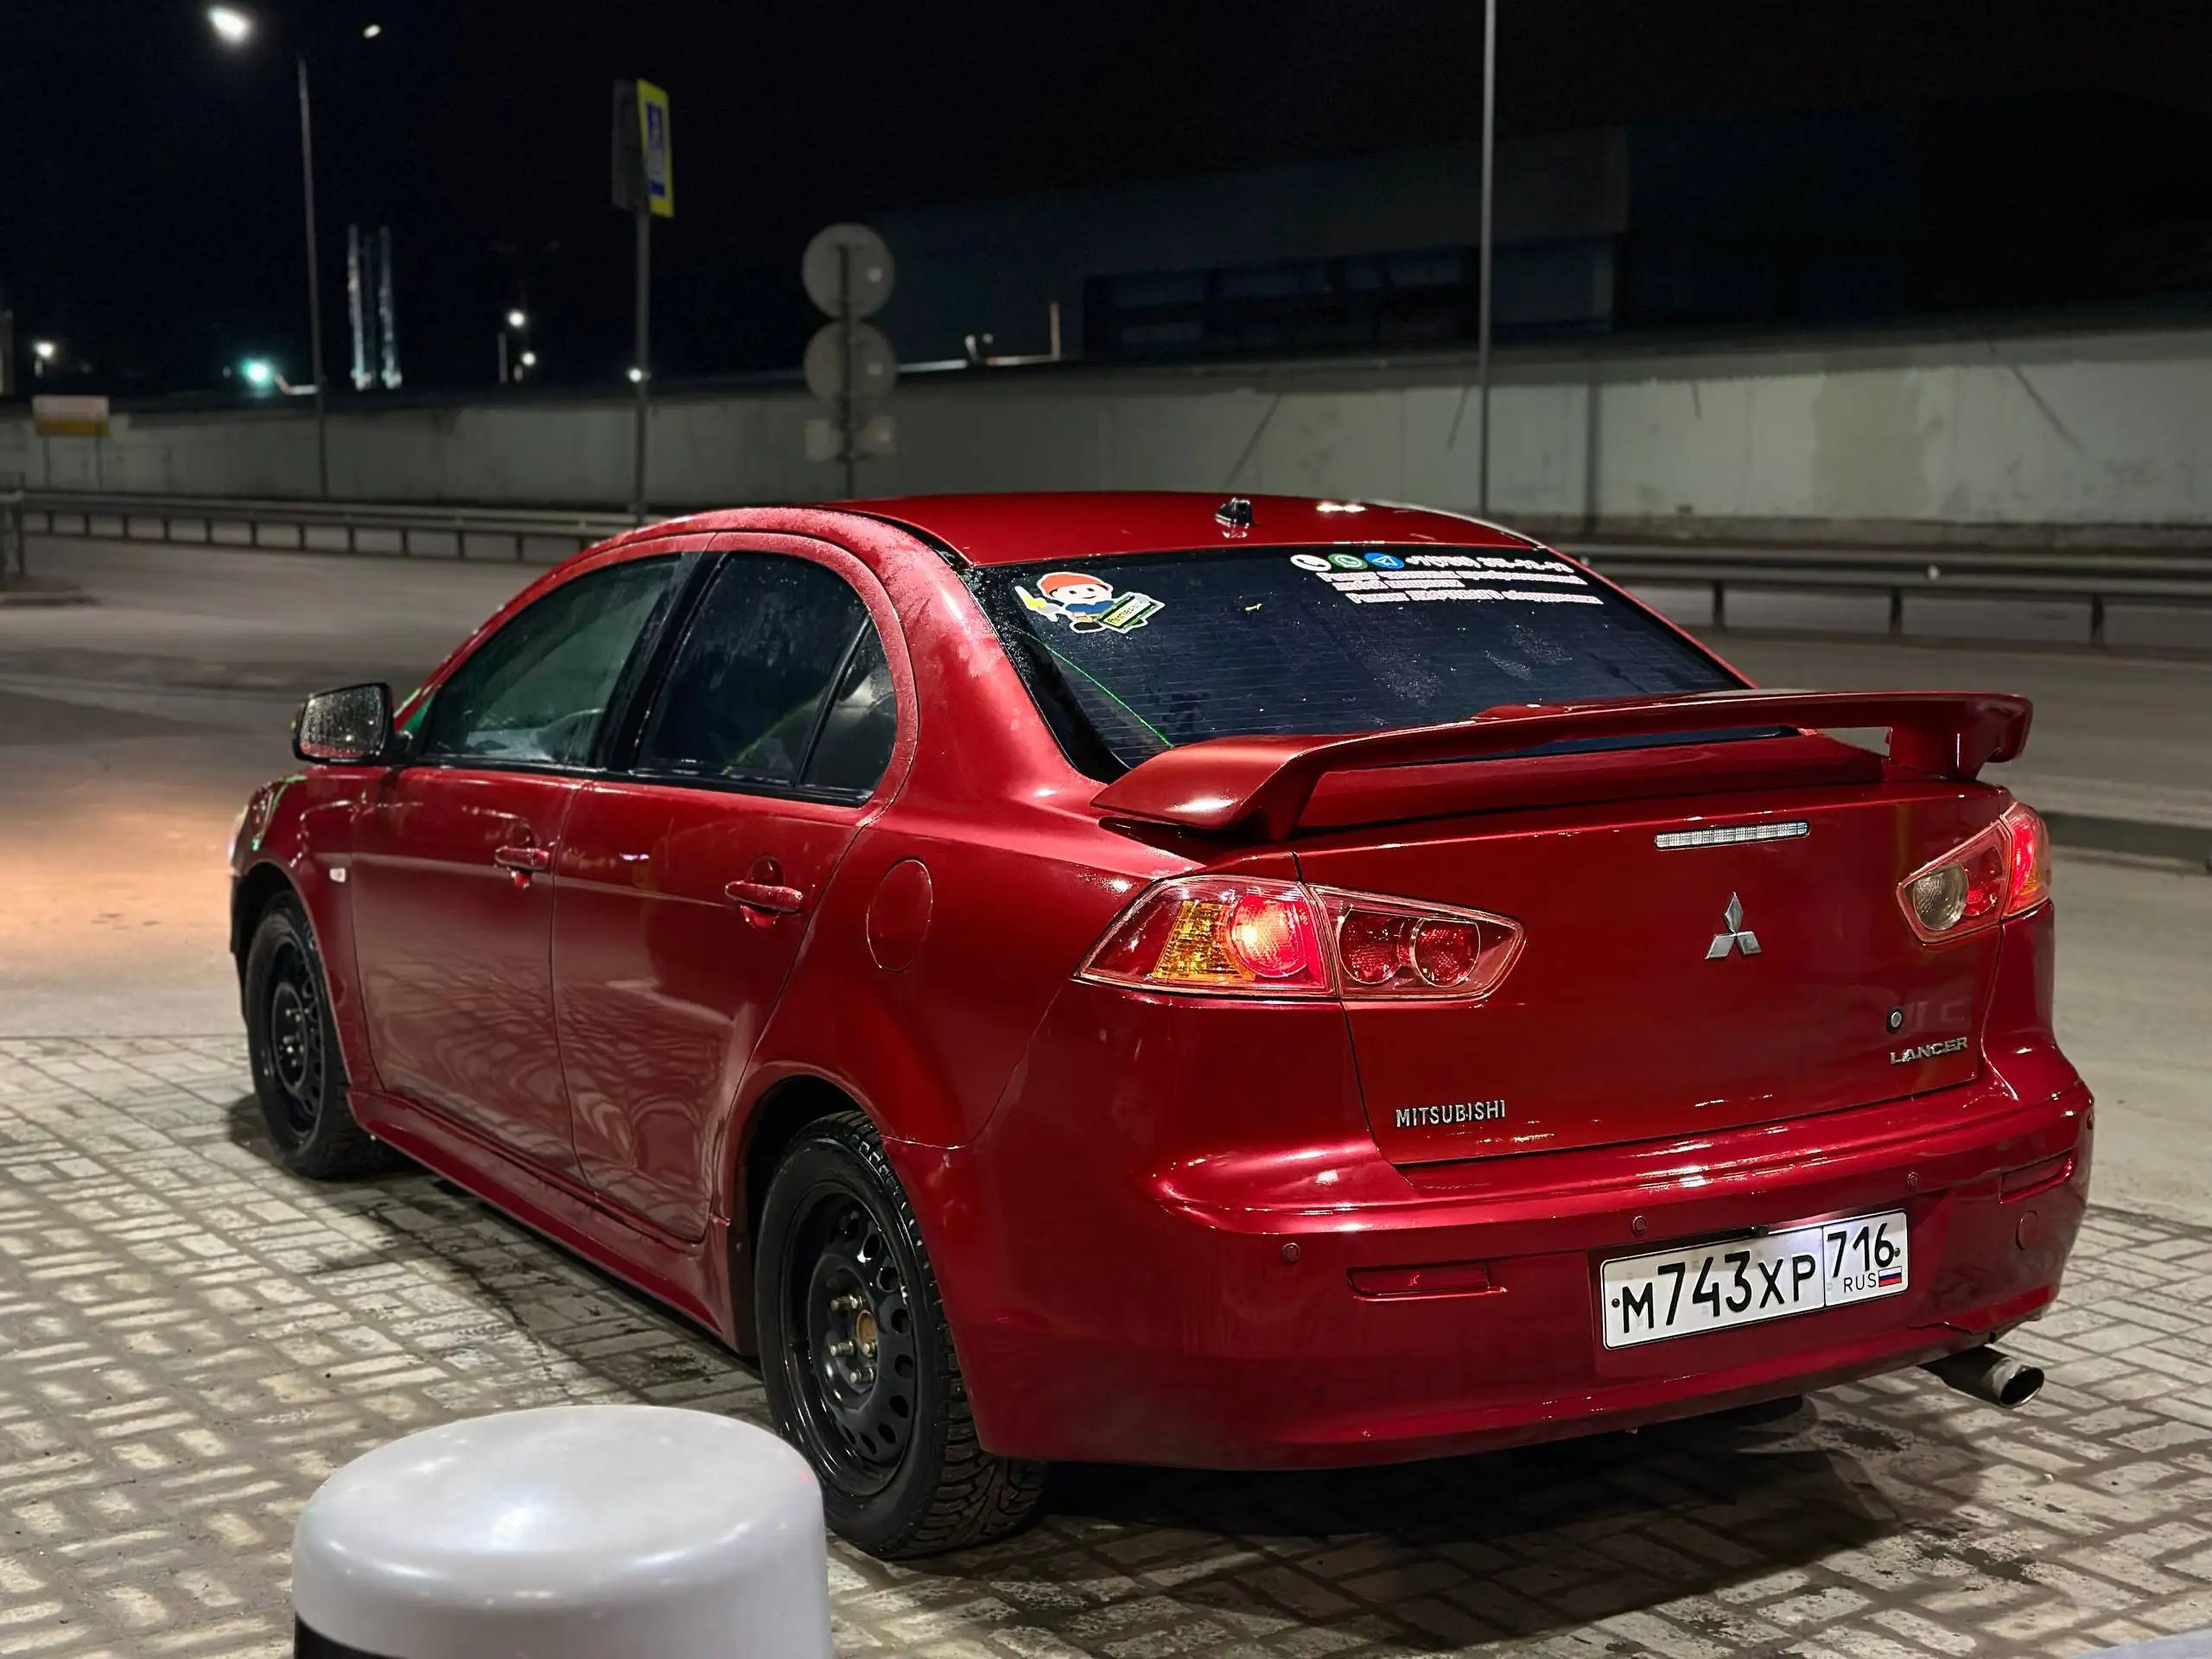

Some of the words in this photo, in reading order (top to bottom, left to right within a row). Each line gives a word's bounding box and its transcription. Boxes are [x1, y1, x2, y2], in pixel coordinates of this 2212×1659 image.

[1890, 1037, 1968, 1065] LANCER
[1395, 1100, 1505, 1128] MITSUBISHI
[1827, 1222, 1895, 1279] 716
[1844, 1272, 1877, 1294] RUS
